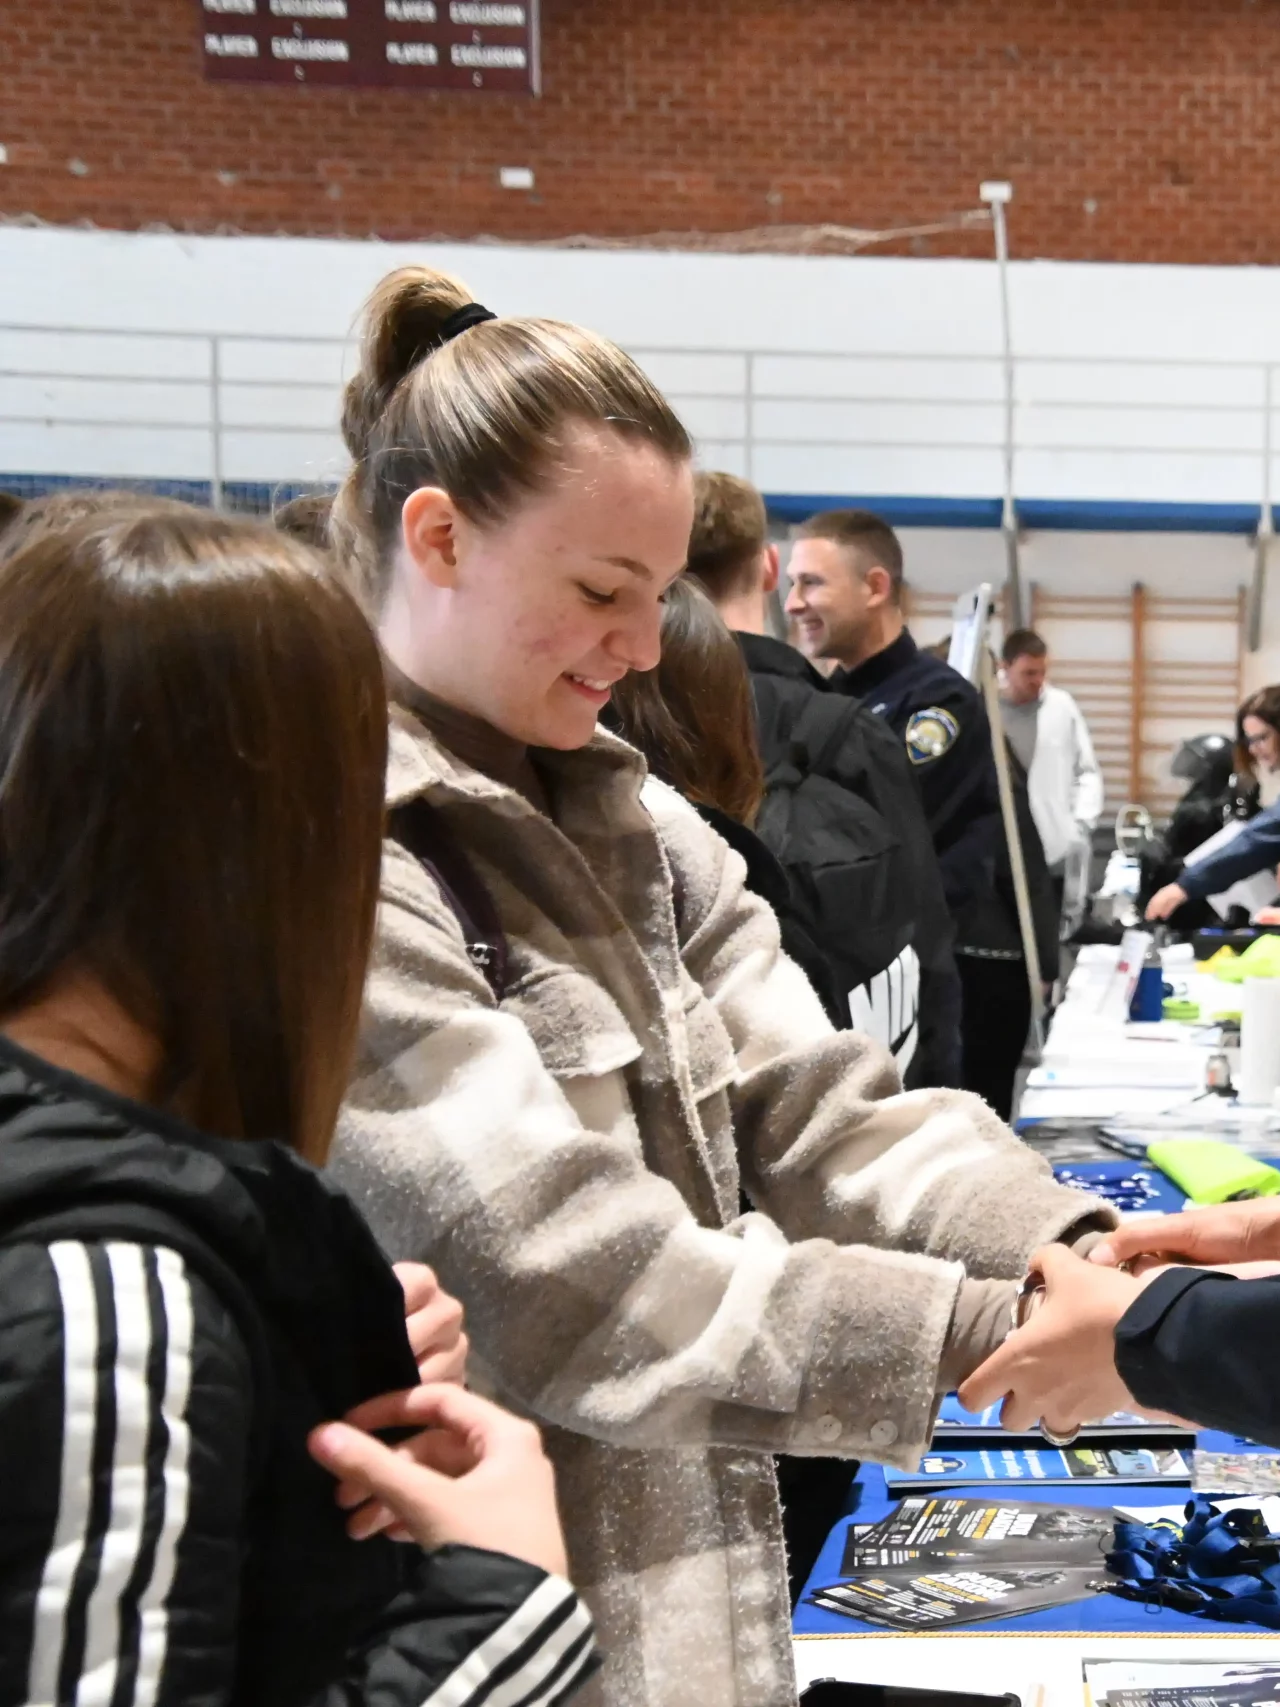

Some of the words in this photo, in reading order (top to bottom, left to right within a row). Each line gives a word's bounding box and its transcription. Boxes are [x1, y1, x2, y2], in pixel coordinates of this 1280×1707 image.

[385, 0, 437, 23] PLAYER
[449, 1, 525, 26] EXCLUSION
[204, 33, 259, 57] PLAYER
[271, 36, 349, 62] EXCLUSION
[386, 42, 438, 66] PLAYER
[451, 44, 526, 69] EXCLUSION
